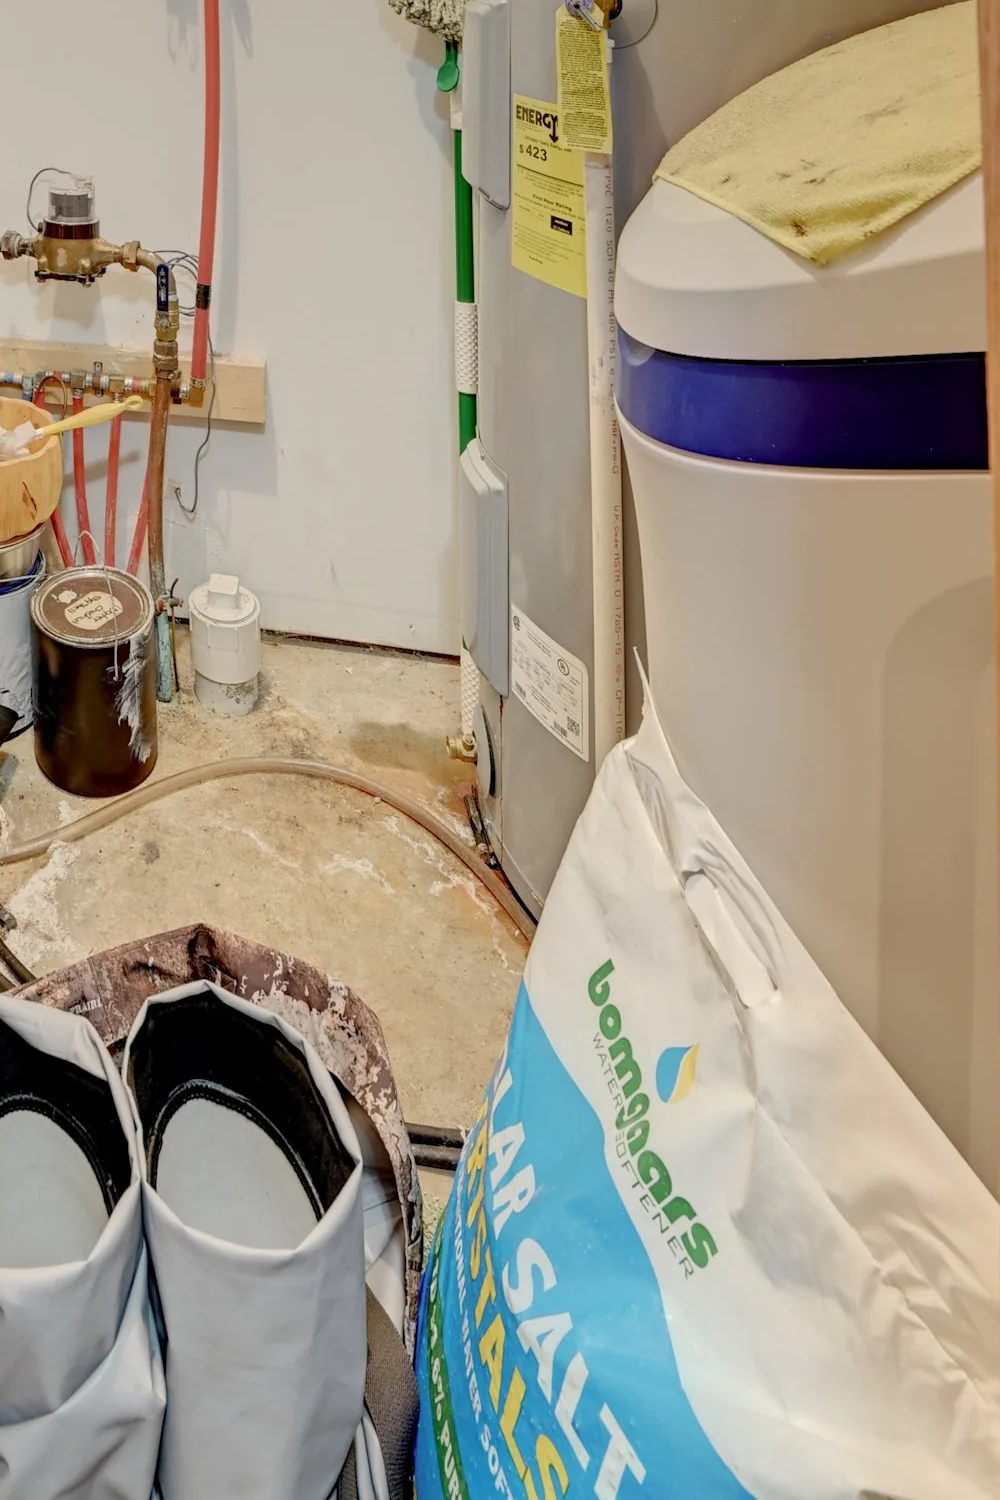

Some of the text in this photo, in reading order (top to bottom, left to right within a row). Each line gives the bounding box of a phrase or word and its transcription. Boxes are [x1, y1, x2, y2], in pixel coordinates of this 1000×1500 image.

[516, 104, 558, 130] ENERGY
[605, 175, 613, 197] PVC
[605, 206, 613, 233] 1120
[606, 240, 614, 262] SCH
[607, 269, 615, 283] 40
[608, 312, 616, 333] 480
[613, 553, 622, 583] ASTM
[614, 590, 622, 598] D
[588, 958, 718, 1270] bomgaars
[592, 1032, 694, 1281] WATER SOFTENER
[502, 1238, 646, 1500] SALT
